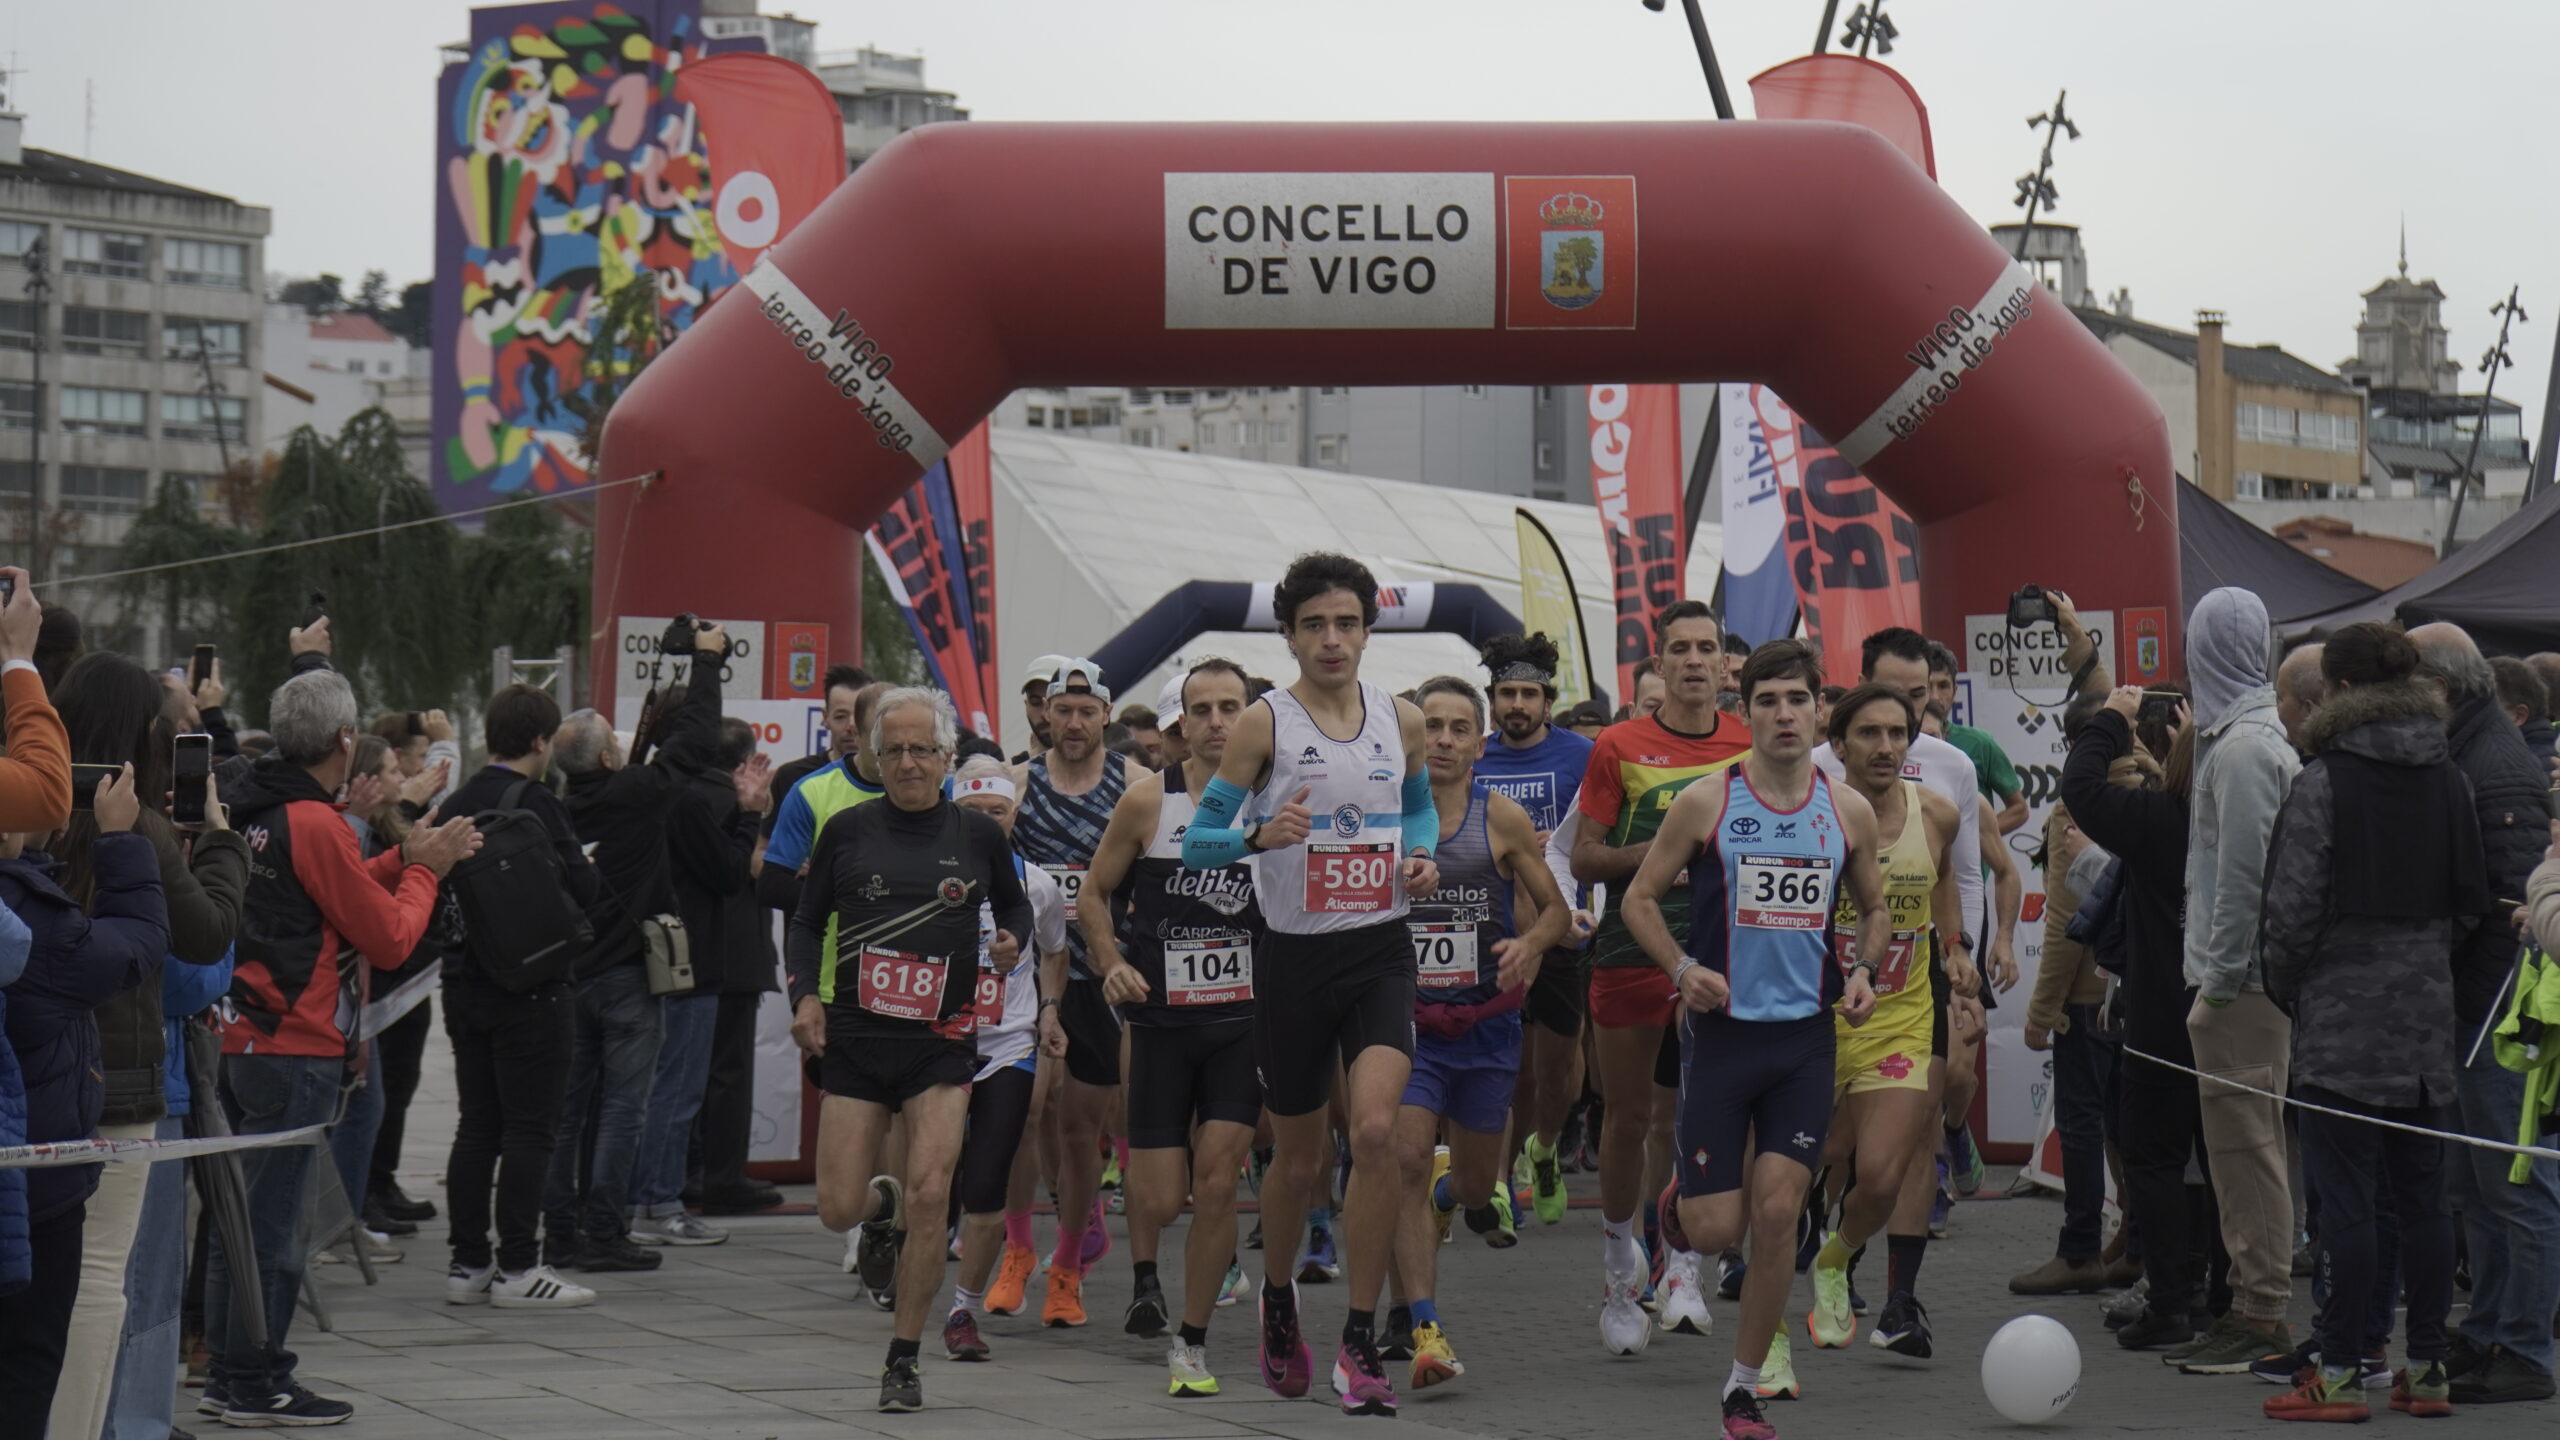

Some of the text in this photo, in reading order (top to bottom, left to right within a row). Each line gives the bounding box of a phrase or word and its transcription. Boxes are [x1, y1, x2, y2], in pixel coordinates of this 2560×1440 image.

[1188, 204, 1469, 243] CONCELLO
[1223, 256, 1437, 296] DE VIGO
[827, 310, 893, 394] VIGO,
[1907, 306, 1986, 372] VIGO,
[761, 291, 914, 451] terreo de xogo
[1886, 286, 2033, 441] terreo de xogo
[1989, 657, 2020, 677] DE
[1728, 836, 1763, 844] NIPOCAR
[1324, 857, 1387, 889] 580
[1755, 870, 1820, 905] 366
[1889, 872, 1928, 882] San Lázaro
[1324, 897, 1379, 912] Alcampo
[1756, 911, 1811, 928] Alcampo
[871, 961, 935, 997] 618
[1182, 951, 1241, 983] 104
[870, 997, 922, 1017] Alcampo
[1186, 989, 1236, 1003] Alcampo
